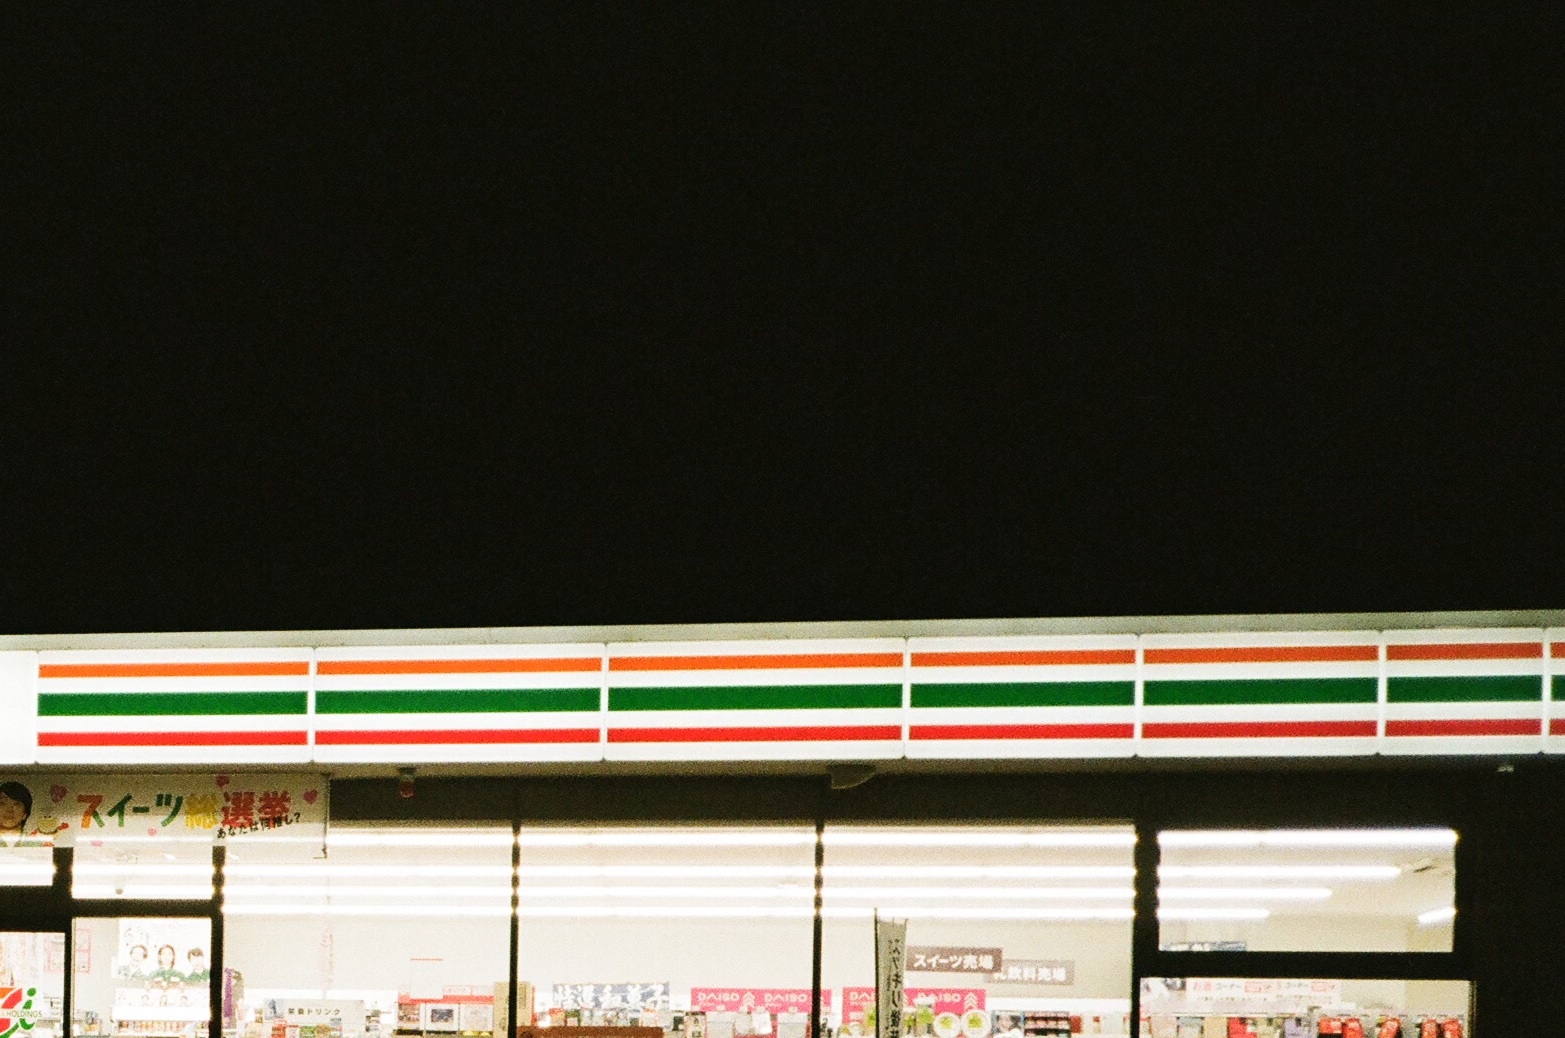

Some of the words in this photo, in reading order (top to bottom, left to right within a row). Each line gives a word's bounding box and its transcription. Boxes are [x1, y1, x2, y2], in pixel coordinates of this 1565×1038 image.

[913, 953, 994, 970] スイーツ売場
[764, 993, 808, 1003] DAISO
